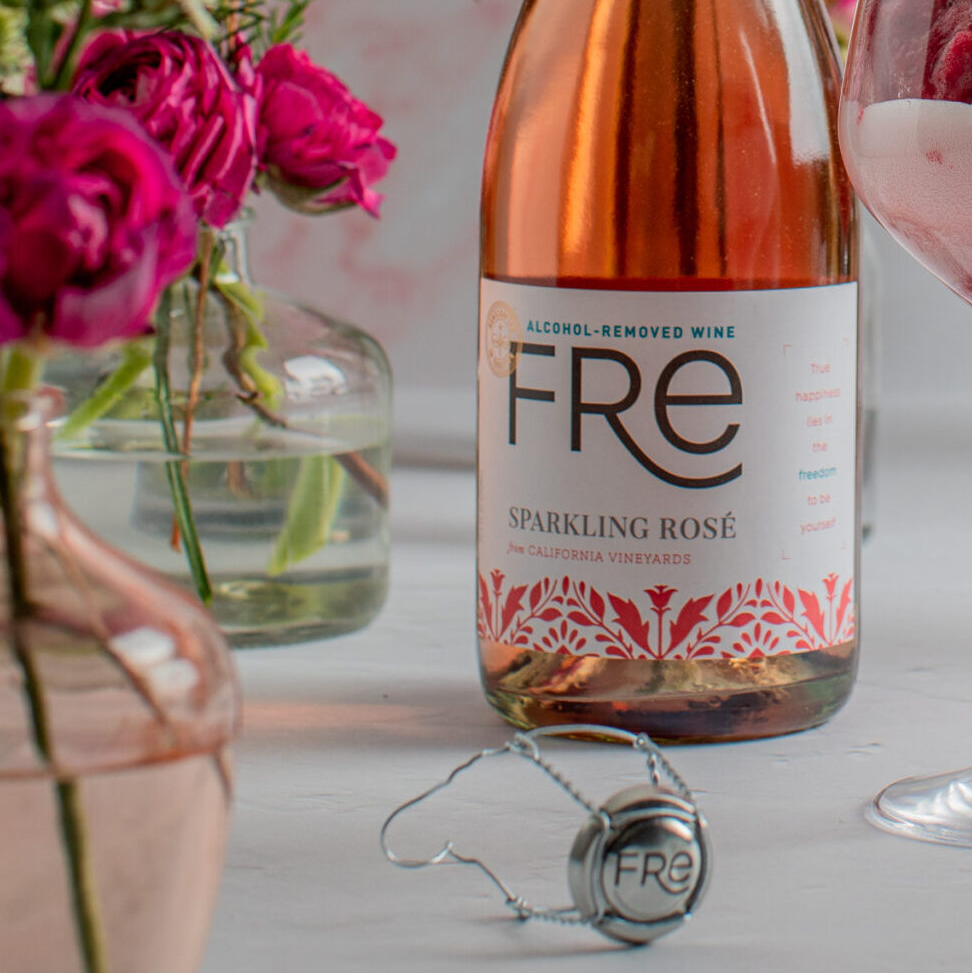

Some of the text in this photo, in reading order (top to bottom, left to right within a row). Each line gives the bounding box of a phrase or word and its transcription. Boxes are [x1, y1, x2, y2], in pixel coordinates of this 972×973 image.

[526, 319, 736, 339] ALCOHOL-REMOVED WINE
[810, 363, 831, 374] True
[795, 388, 840, 402] happiness
[508, 340, 743, 489] FRe
[812, 441, 828, 453] the
[798, 467, 837, 481] freedom
[807, 493, 831, 506] to be
[508, 506, 737, 540] SPARKLING ROSÉ
[800, 516, 836, 535] yourself
[527, 544, 604, 563] CALIFORNIA
[608, 551, 692, 565] VINEYARDS
[614, 851, 693, 895] FRe
